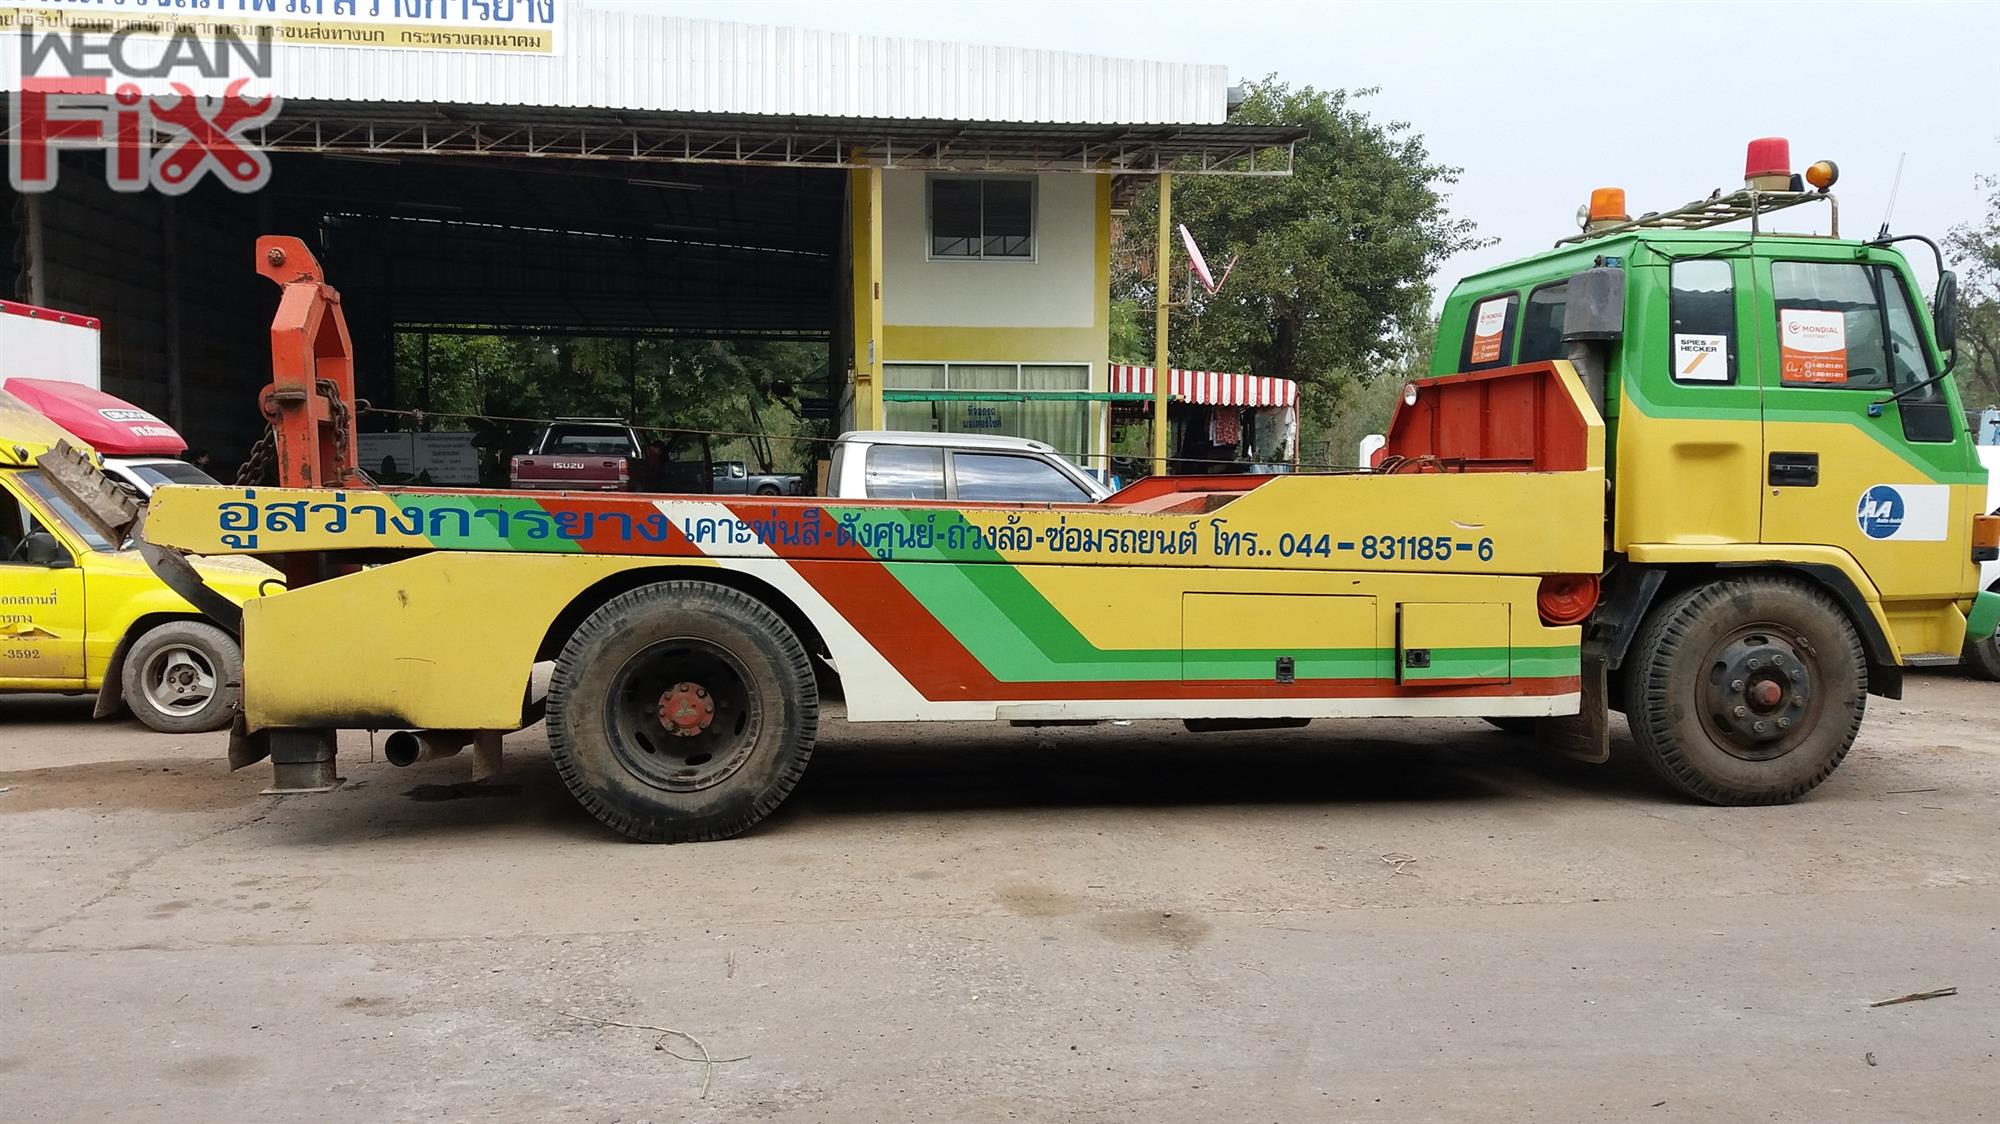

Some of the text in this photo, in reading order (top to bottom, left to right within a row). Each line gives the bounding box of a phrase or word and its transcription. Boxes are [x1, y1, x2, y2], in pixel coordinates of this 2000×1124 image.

[400, 31, 541, 48] กระทรวงคมนาคม
[1802, 326, 1839, 334] MONDIAL
[1680, 345, 1718, 353] HECKER
[552, 462, 585, 470] ISUZU
[218, 490, 668, 549] อู่สว่างการยาง
